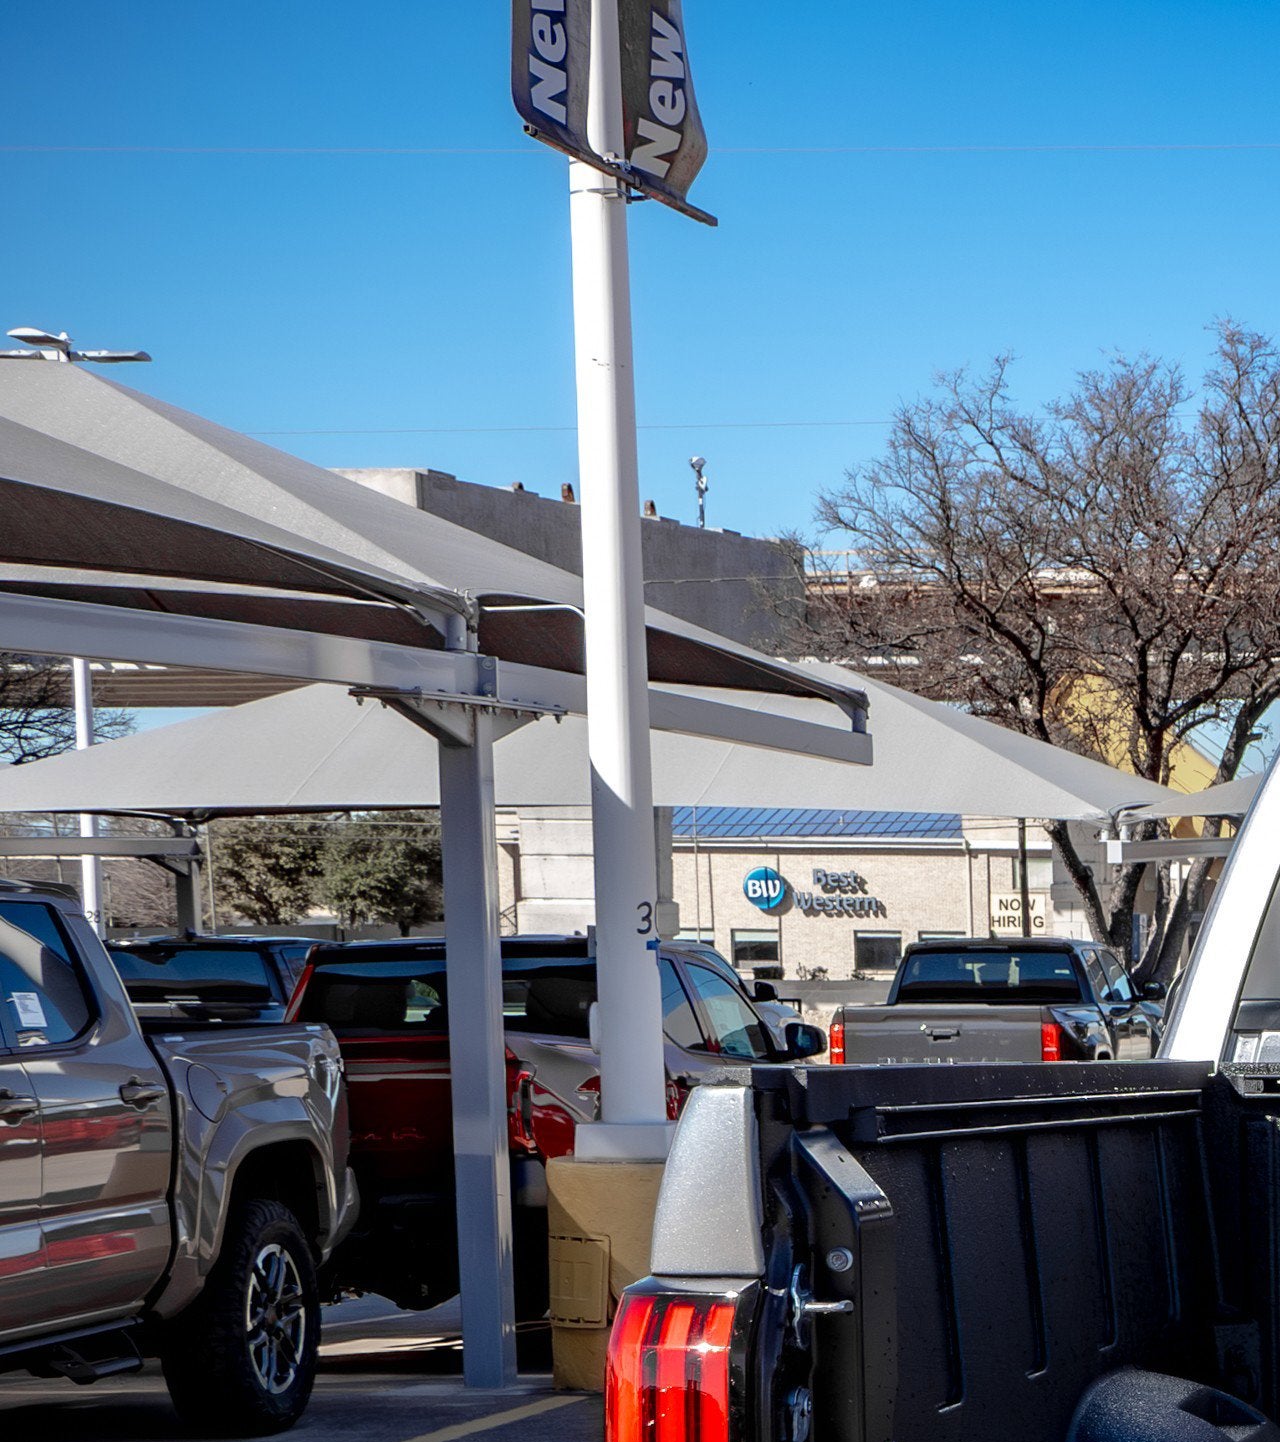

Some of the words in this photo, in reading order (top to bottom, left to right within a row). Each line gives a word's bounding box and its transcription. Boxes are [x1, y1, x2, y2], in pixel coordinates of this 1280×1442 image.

[529, 0, 568, 125] Ne
[630, 11, 687, 179] New
[812, 868, 859, 887] Best
[747, 879, 780, 898] BW
[792, 891, 878, 911] Western
[636, 901, 653, 935] 3
[991, 915, 1045, 928] HIRIG
